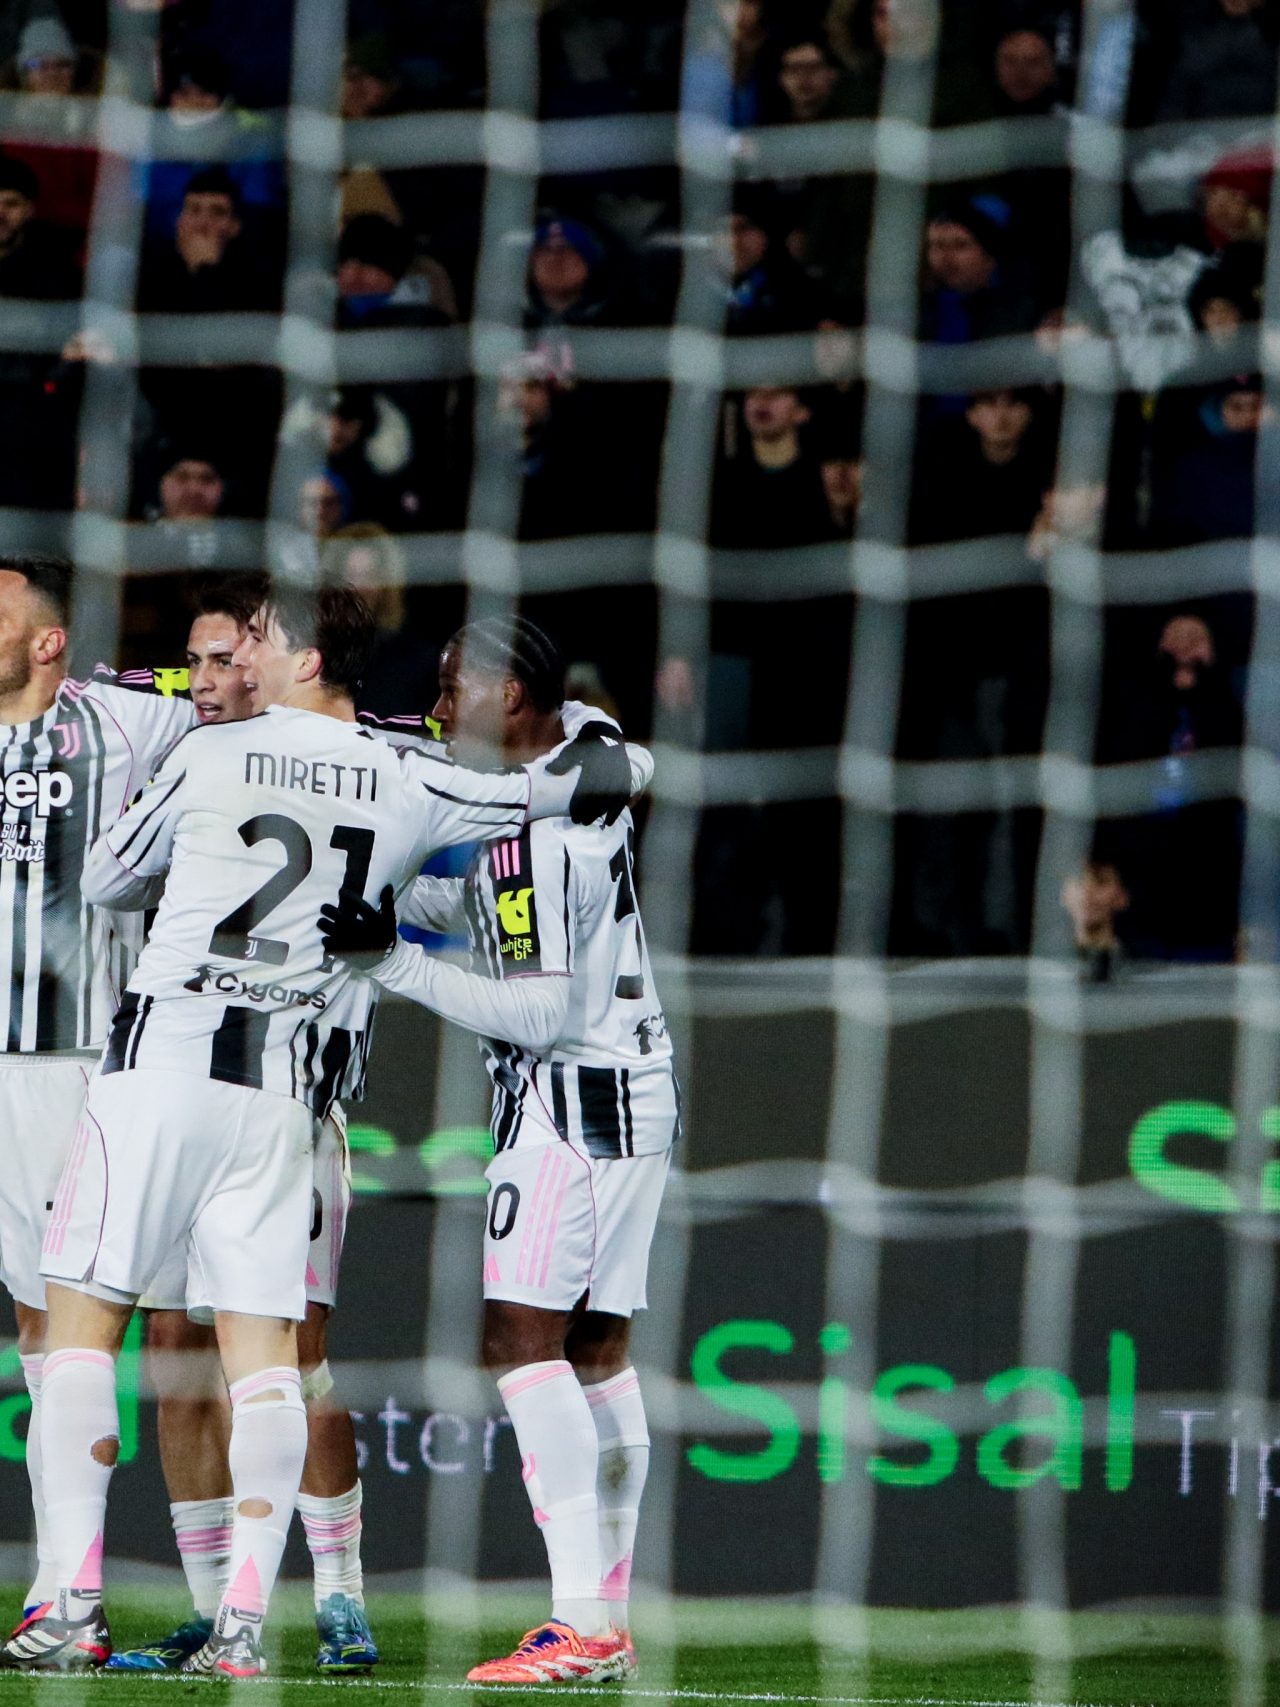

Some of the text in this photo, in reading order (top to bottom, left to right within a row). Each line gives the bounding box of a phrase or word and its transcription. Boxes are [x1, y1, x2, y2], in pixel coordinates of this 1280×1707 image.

[244, 752, 377, 802] MIRETTI
[208, 813, 376, 974] 21
[500, 937, 532, 953] white
[687, 1320, 1136, 1491] Sisal
